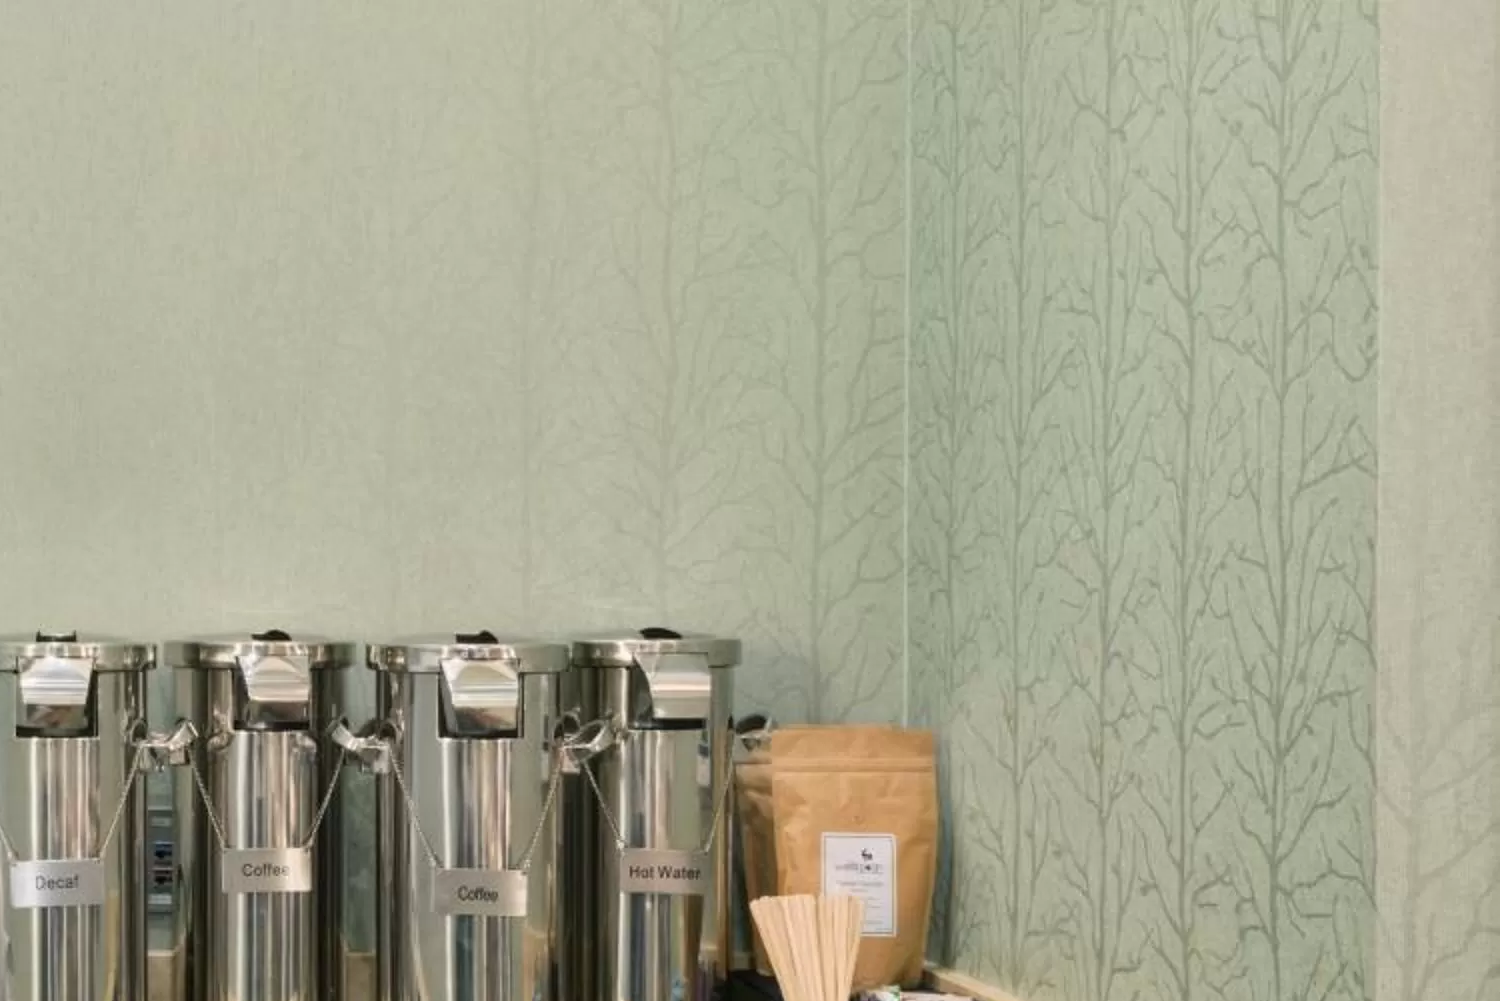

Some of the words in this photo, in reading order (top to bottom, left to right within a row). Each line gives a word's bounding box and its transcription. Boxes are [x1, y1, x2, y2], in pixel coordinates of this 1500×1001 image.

[241, 863, 290, 877] Coffee
[628, 866, 655, 879] Hot
[657, 866, 701, 880] Water
[35, 874, 79, 891] Decaf
[456, 885, 499, 902] Coffee
